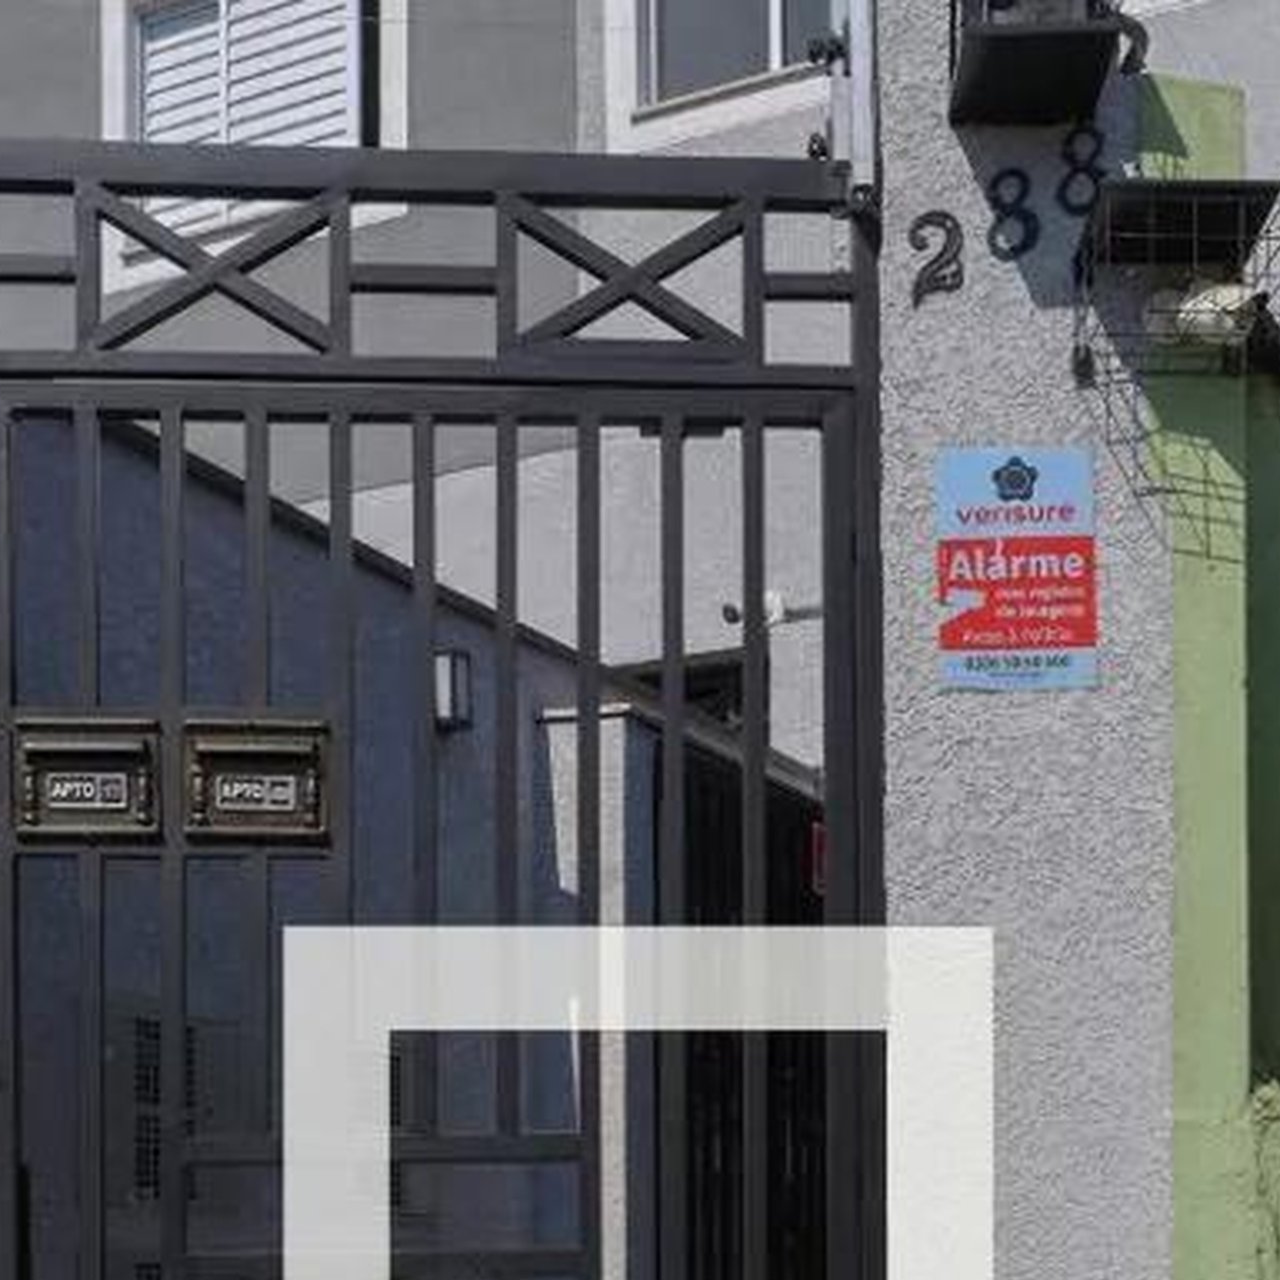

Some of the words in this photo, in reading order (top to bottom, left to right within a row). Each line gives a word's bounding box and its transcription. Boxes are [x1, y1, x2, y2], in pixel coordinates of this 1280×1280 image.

[907, 128, 1105, 311] 288
[956, 503, 1077, 526] verisure
[52, 781, 95, 798] APTO
[222, 782, 264, 799] APTO
